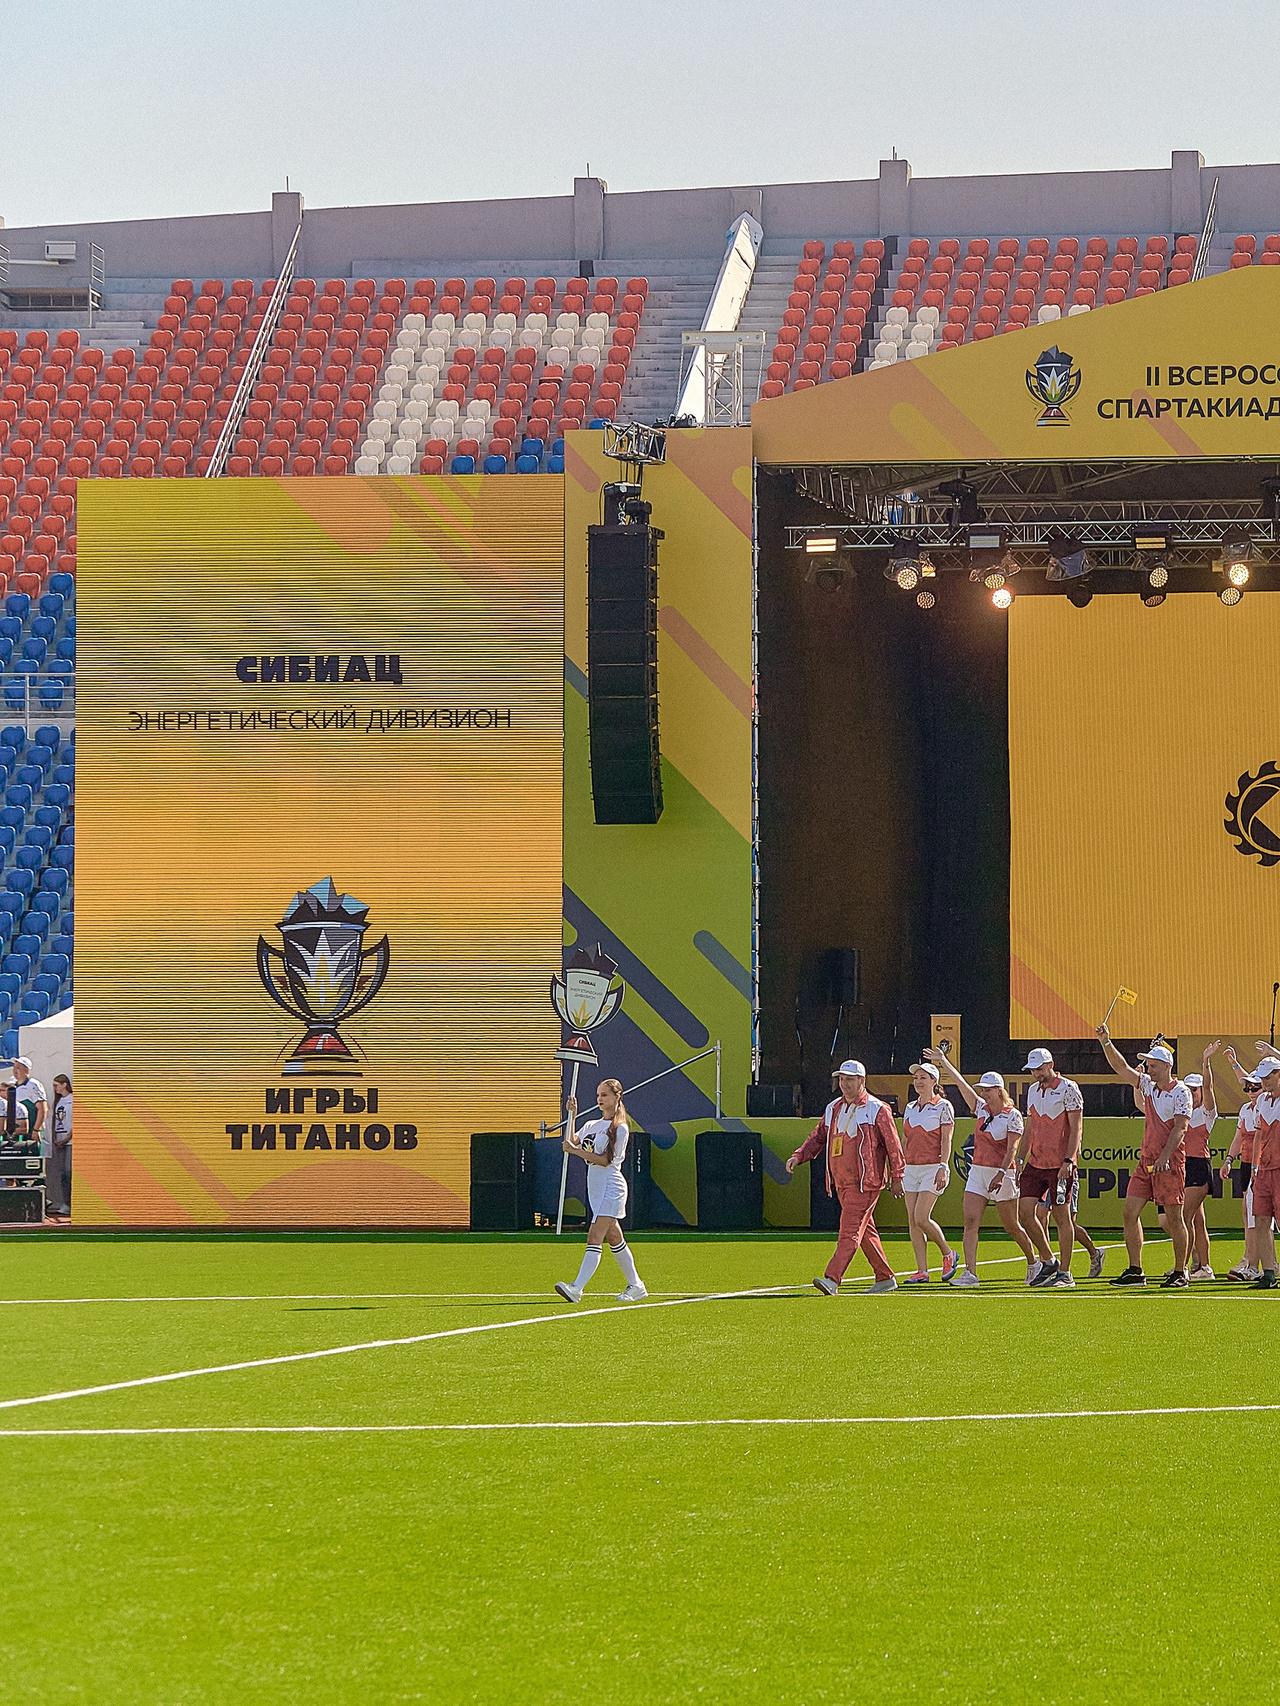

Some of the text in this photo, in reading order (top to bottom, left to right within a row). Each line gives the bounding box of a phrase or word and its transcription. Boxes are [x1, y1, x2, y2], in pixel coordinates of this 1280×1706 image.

[235, 655, 403, 684] СИБИАЦ
[127, 705, 512, 733] ЭНЕРГЕТИЧЕСКИЙ ДИВИЗИОН
[265, 1087, 379, 1114] ИГРЫ
[225, 1123, 418, 1151] ТИТАНОВ
